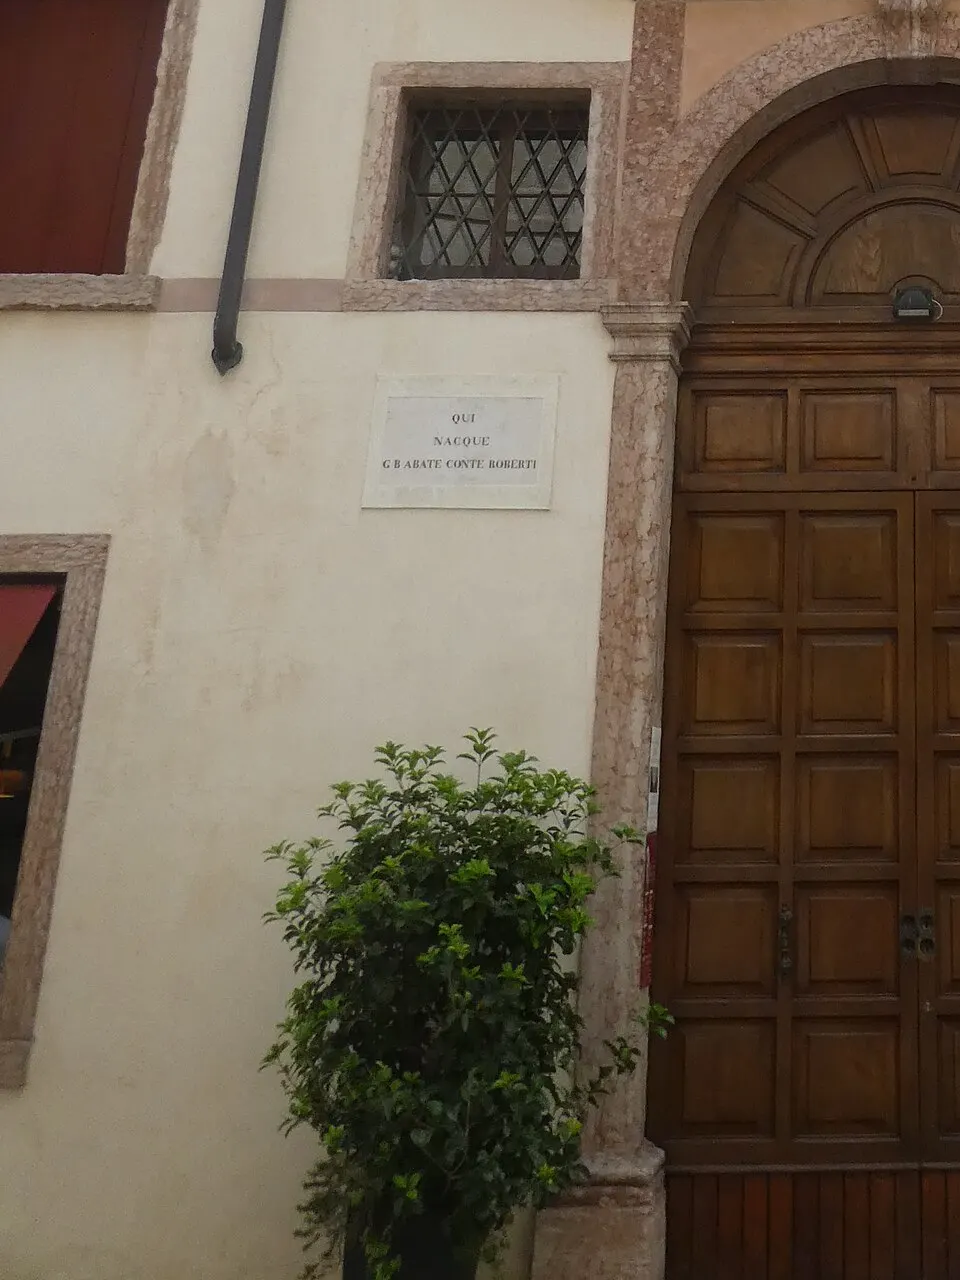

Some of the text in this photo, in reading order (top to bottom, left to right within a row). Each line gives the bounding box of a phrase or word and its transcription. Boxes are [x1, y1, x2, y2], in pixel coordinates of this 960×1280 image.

[452, 413, 475, 424] QUI
[434, 436, 490, 447] NACQUE
[382, 459, 537, 469] G B ABATE CONTE ROBERTI
